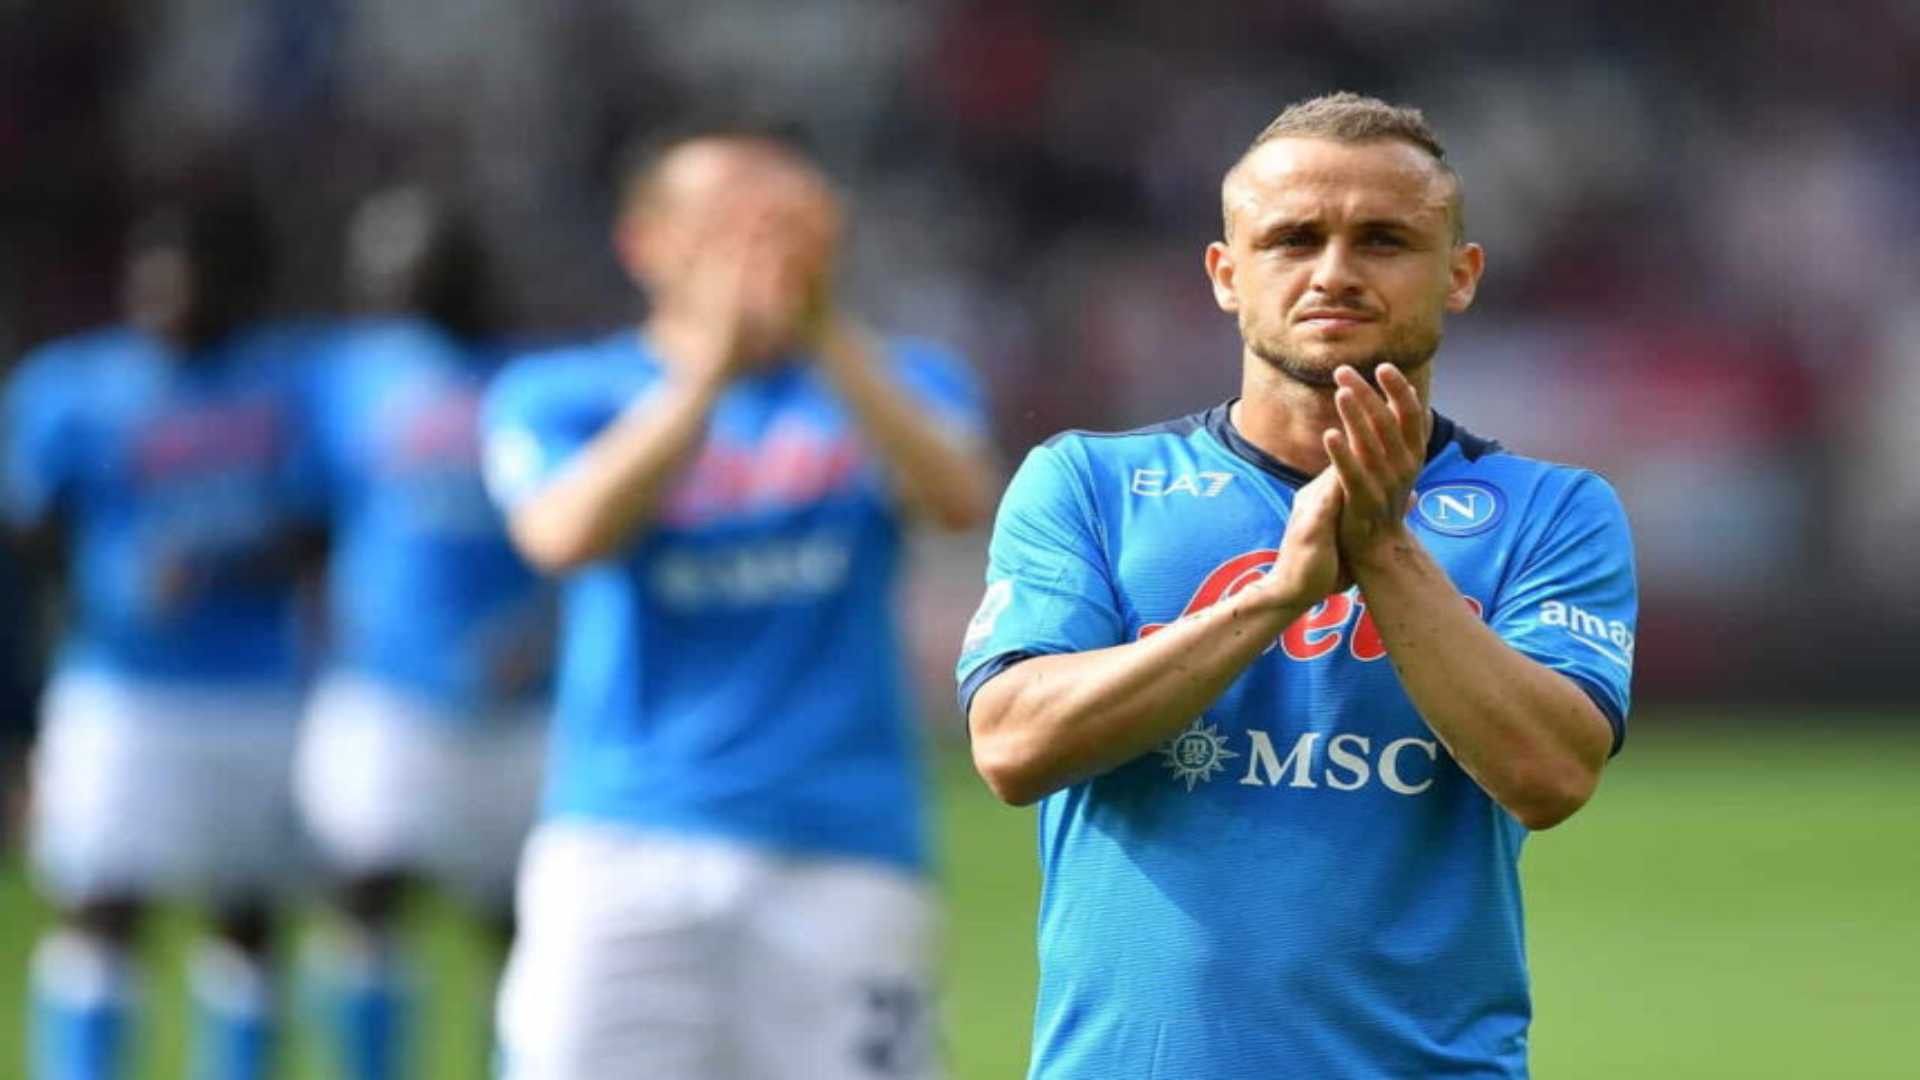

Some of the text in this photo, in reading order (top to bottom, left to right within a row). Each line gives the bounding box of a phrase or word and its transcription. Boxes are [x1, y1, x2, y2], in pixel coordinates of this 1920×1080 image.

[1131, 468, 1233, 497] EA7
[1434, 493, 1479, 520] N
[1240, 729, 1437, 795] MSC
